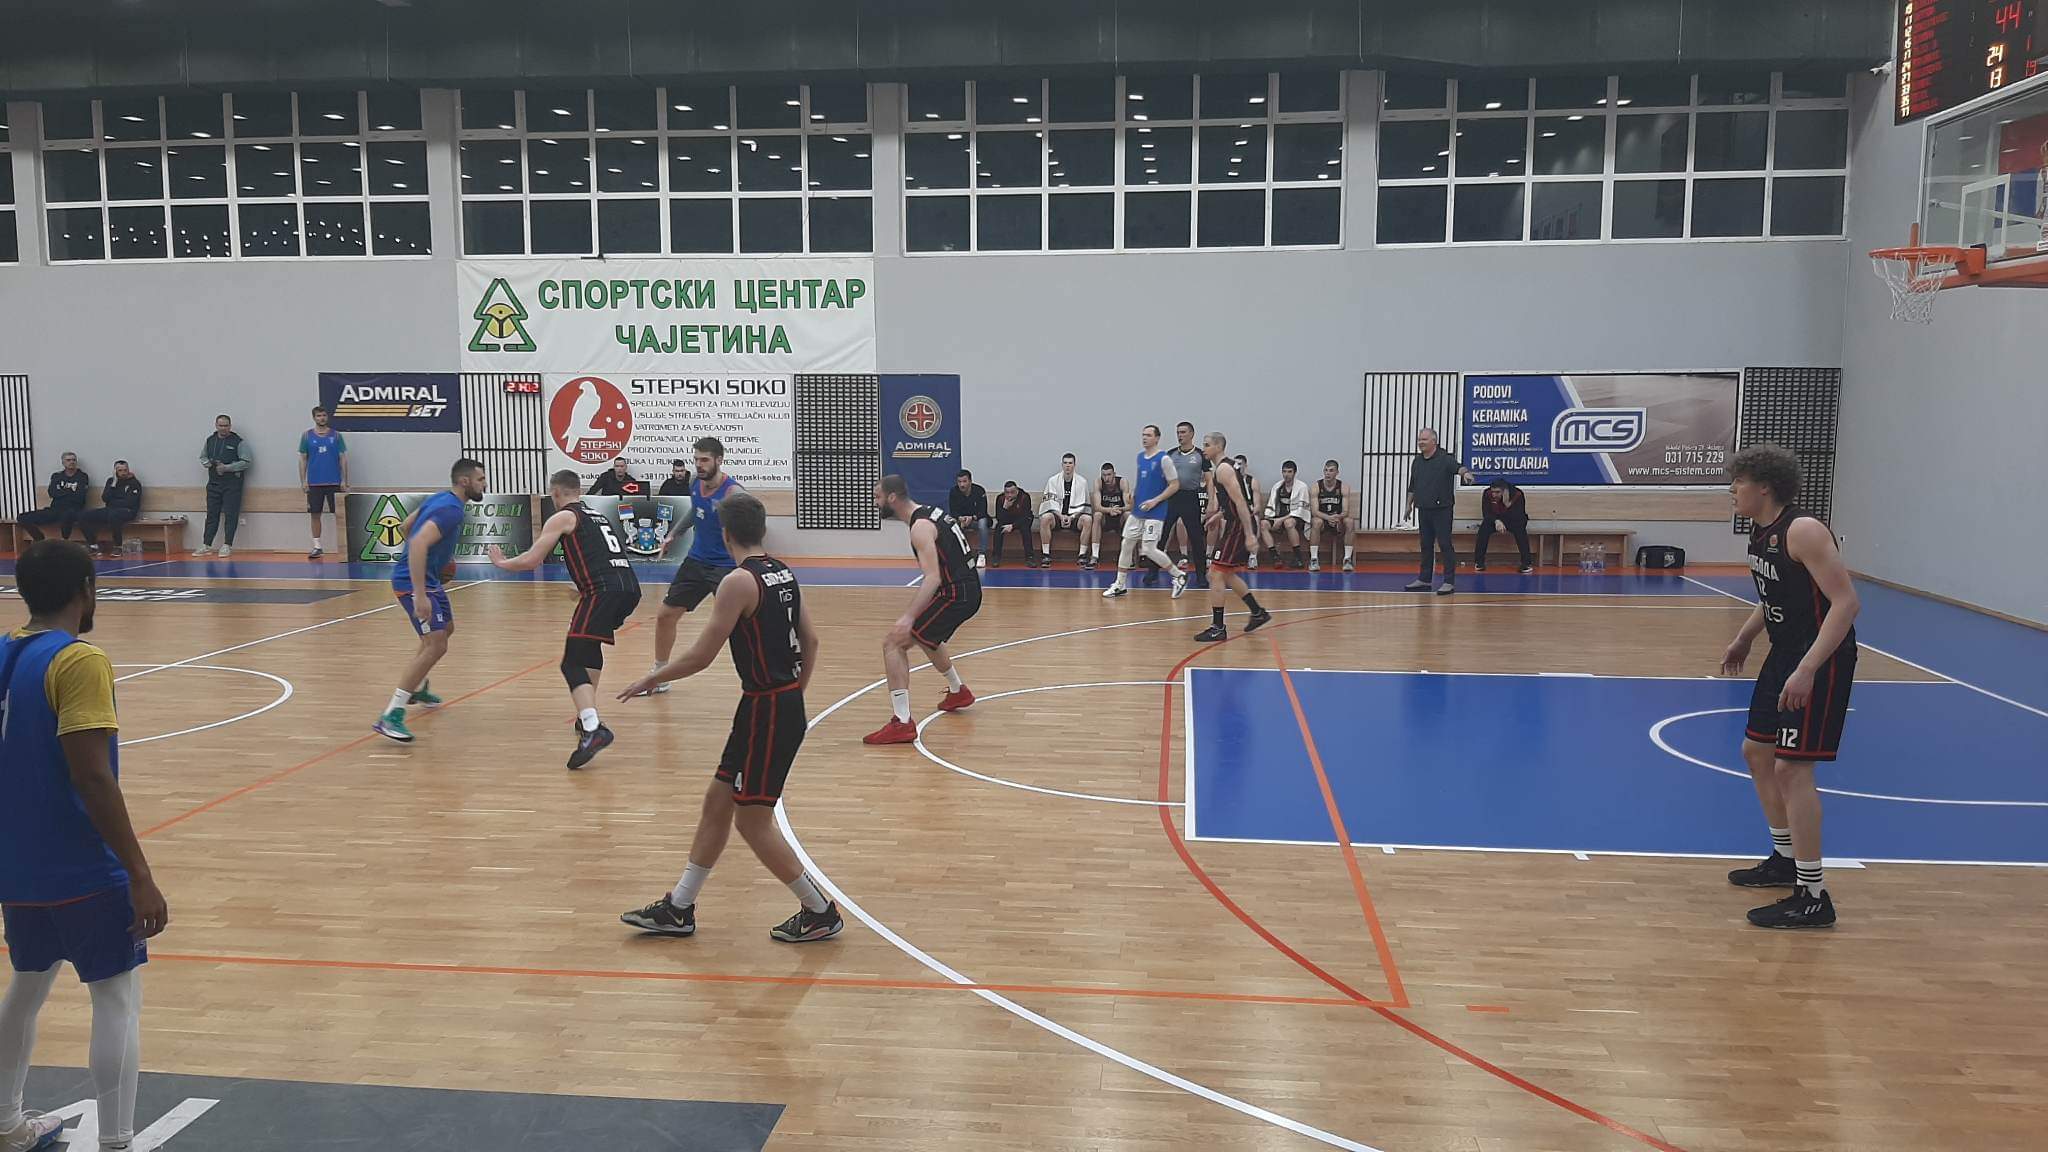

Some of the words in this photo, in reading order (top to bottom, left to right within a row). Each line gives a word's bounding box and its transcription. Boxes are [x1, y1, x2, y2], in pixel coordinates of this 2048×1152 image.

[1995, 1, 2022, 33] 44
[1987, 44, 2004, 67] 24
[1990, 66, 2003, 89] 13
[537, 278, 716, 310] СПОРТСКИ
[734, 278, 867, 314] ЦЕНТАР
[615, 324, 793, 354] ЧАЈЕТИНА
[339, 384, 448, 403] ADMIRAL
[631, 379, 720, 395] STEPSKI
[727, 379, 786, 395] SOKO
[1473, 385, 1512, 399] PODOVI
[409, 404, 447, 417] BET
[1472, 408, 1528, 423] KERAMIKA
[581, 440, 622, 450] STEPSKI
[724, 435, 760, 443] OPREME
[895, 441, 952, 451] ADMIRAL
[1472, 432, 1531, 446] SANITARIJE
[581, 452, 609, 461] SOKO
[1471, 456, 1491, 469] PVC
[1494, 456, 1549, 469] STOLARIJA
[1665, 451, 1681, 463] 031
[1686, 451, 1703, 463] 715
[1706, 451, 1724, 463] 229
[1628, 466, 1723, 476] www.mcs-sistem.com
[1146, 525, 1154, 535] 9
[600, 525, 622, 554] 6
[1781, 728, 1798, 748] 12
[734, 771, 743, 792] 4
